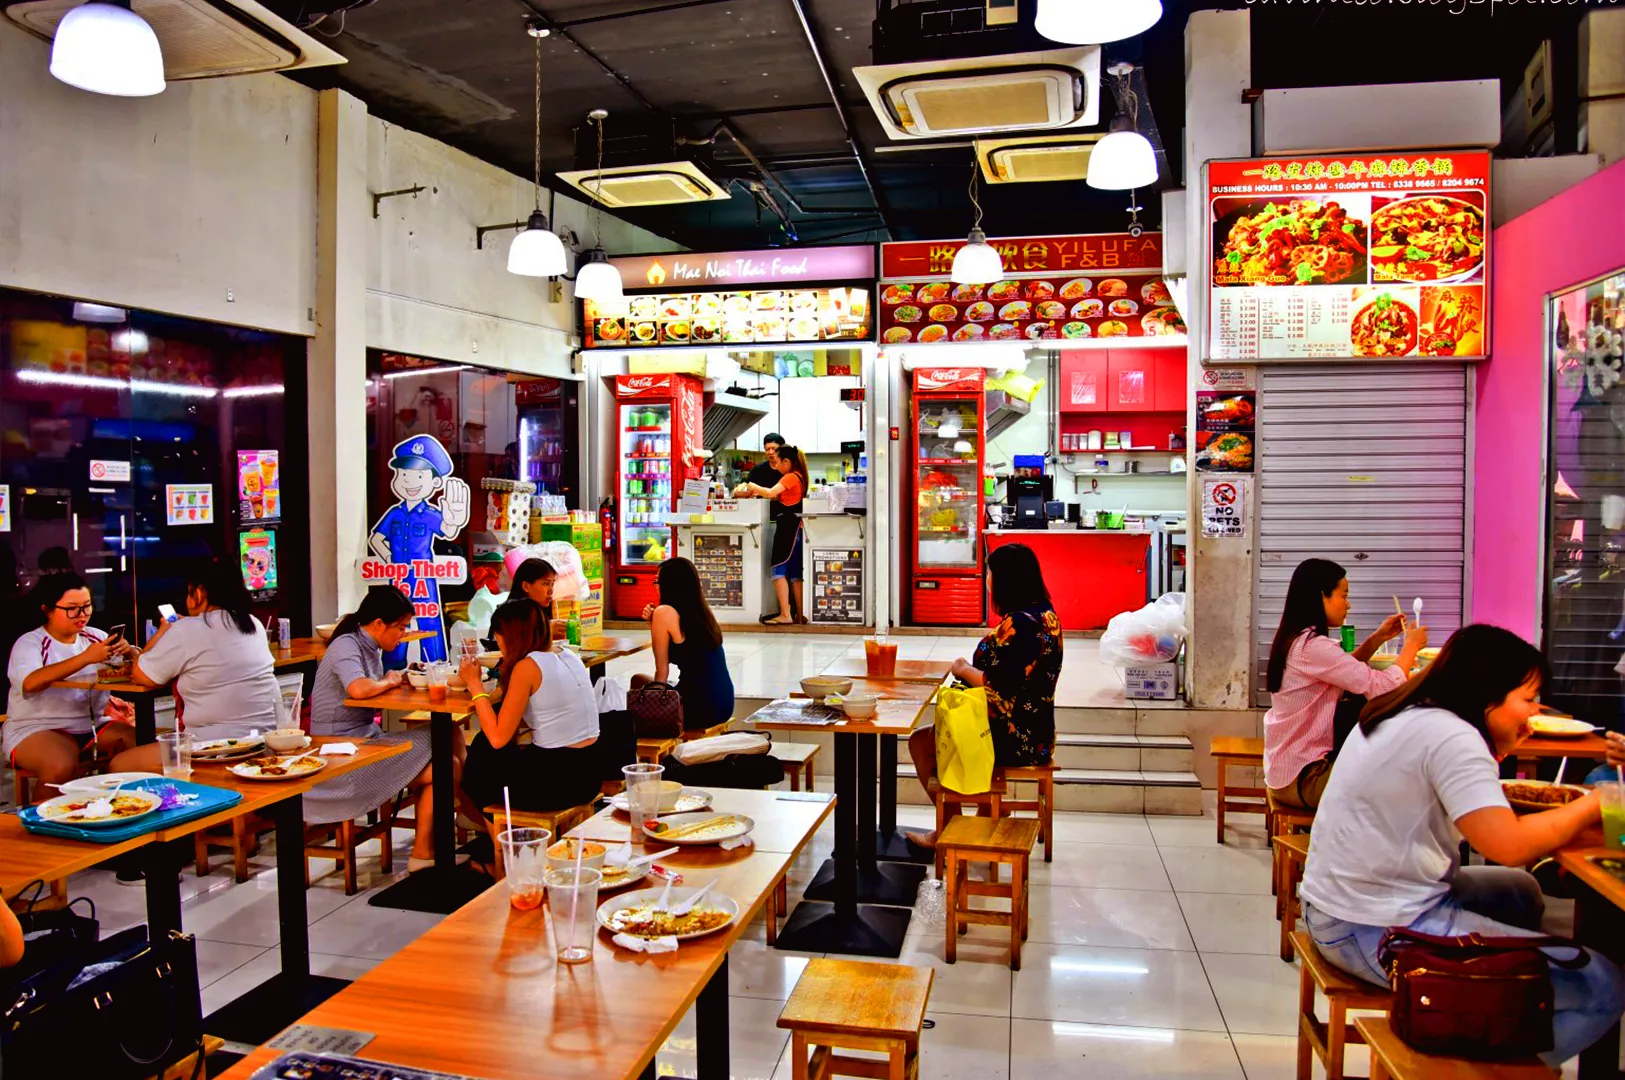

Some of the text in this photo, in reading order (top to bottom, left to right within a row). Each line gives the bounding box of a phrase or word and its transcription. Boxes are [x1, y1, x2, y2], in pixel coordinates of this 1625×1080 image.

[1212, 184, 1252, 193] BUSINESS
[1255, 184, 1283, 192] HOURS
[1290, 183, 1312, 191] 10:30
[1314, 182, 1327, 190] AM
[1334, 181, 1368, 190] 10:00PM
[1371, 180, 1386, 188] TEL
[673, 257, 808, 279] Mae Noi Thai Food
[1268, 274, 1287, 282] Guo
[850, 388, 865, 401] 30
[1215, 506, 1234, 516] NO
[361, 561, 460, 580] Shop Theft
[414, 580, 429, 597] A
